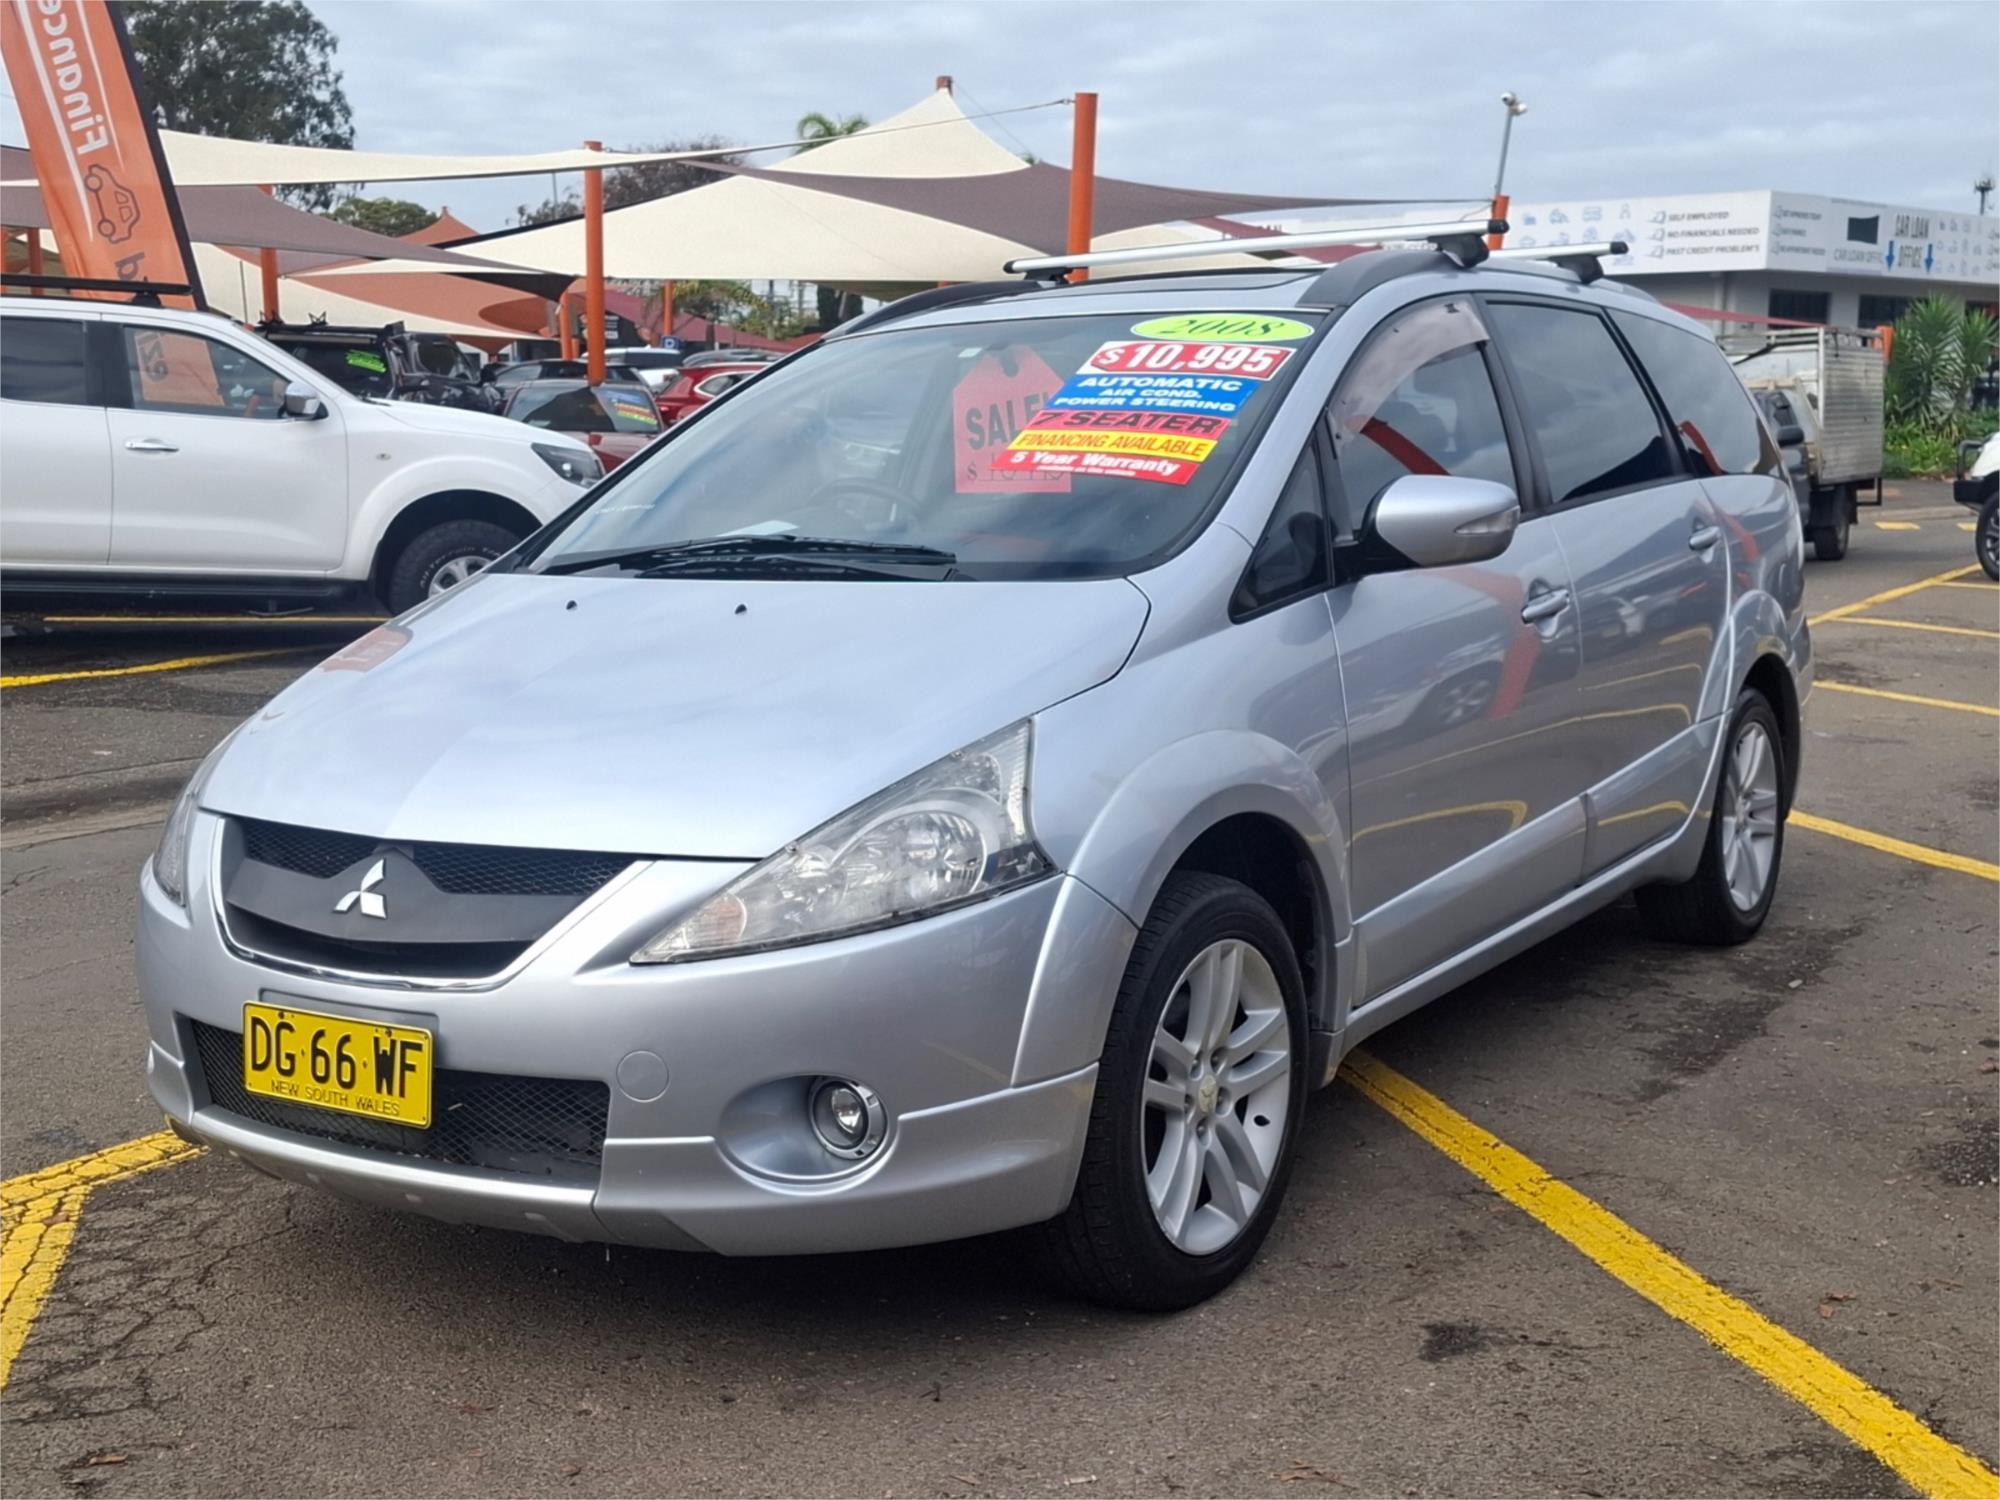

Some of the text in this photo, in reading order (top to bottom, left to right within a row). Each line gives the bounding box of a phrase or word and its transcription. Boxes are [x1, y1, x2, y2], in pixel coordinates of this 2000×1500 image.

[1668, 211, 1729, 222] SELF EMPLOYED
[1895, 214, 1929, 239] CAR LOAN
[1680, 228, 1726, 238] FINANCIALS
[1728, 227, 1760, 236] NEEDED
[1686, 246, 1713, 255] CREDIT
[1898, 245, 1922, 268] OFFICE
[1157, 319, 1286, 337] 2008
[1098, 343, 1281, 373] $10,995
[1076, 377, 1243, 392] AUTOMATIC
[1099, 388, 1203, 399] AIR COND.
[1054, 397, 1236, 412] POWER STEERING
[1031, 411, 1221, 434] 7 SEATER
[1015, 433, 1208, 458] FINANCING AVAILABLE
[1010, 451, 1029, 463] 5
[1031, 451, 1080, 465] Year
[1081, 453, 1181, 476] Warranty
[271, 1079, 400, 1116] NEW SOUTH WALES
